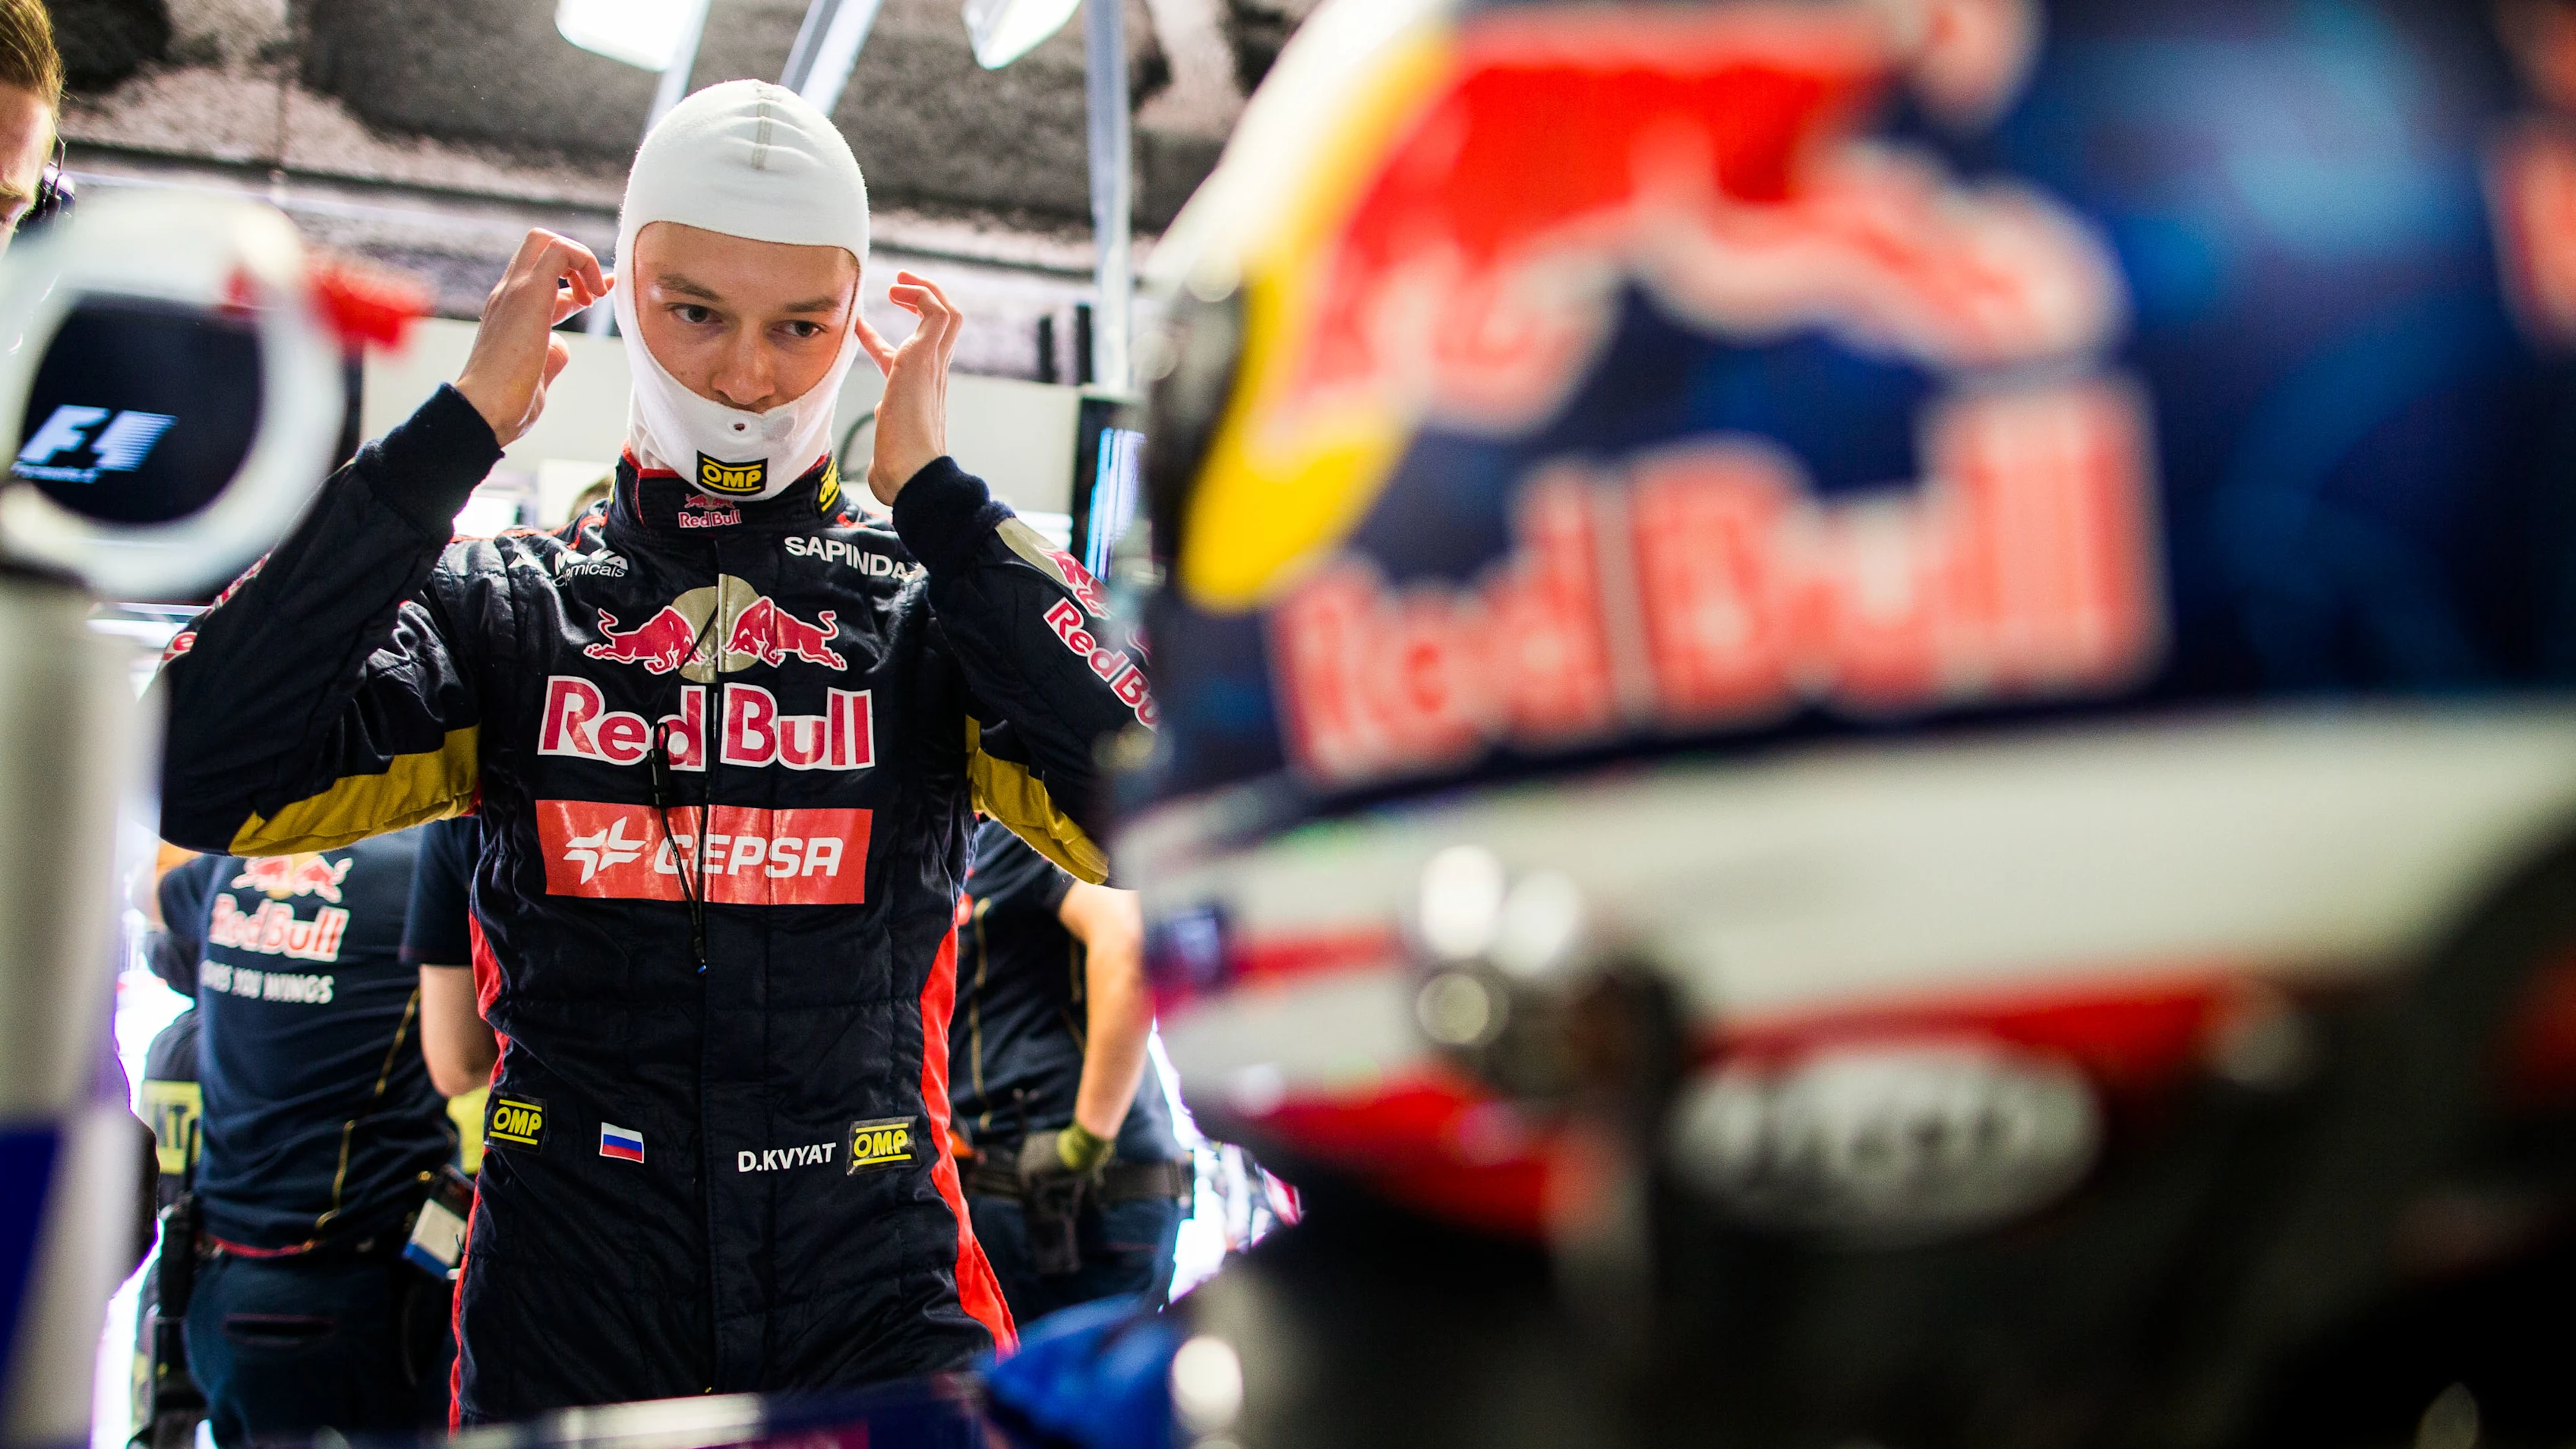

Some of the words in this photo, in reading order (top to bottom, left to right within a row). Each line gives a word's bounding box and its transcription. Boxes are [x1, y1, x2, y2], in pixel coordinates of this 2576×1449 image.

[18, 404, 178, 472] F1
[702, 464, 762, 488] OMP
[678, 511, 711, 528] Red
[711, 509, 742, 526] Bull
[784, 536, 914, 583] SAPINDA
[1043, 597, 1131, 683] Red
[1110, 663, 1160, 734] Bu
[538, 675, 706, 772] Red
[720, 682, 876, 771] Bull
[653, 833, 844, 878] CEPSA
[208, 893, 273, 952] Red
[258, 901, 350, 962] Bull
[263, 971, 334, 1005] WINGS
[493, 1106, 542, 1137] OMP
[737, 1141, 837, 1173] D.KVYAT
[854, 1129, 908, 1159] OMP
